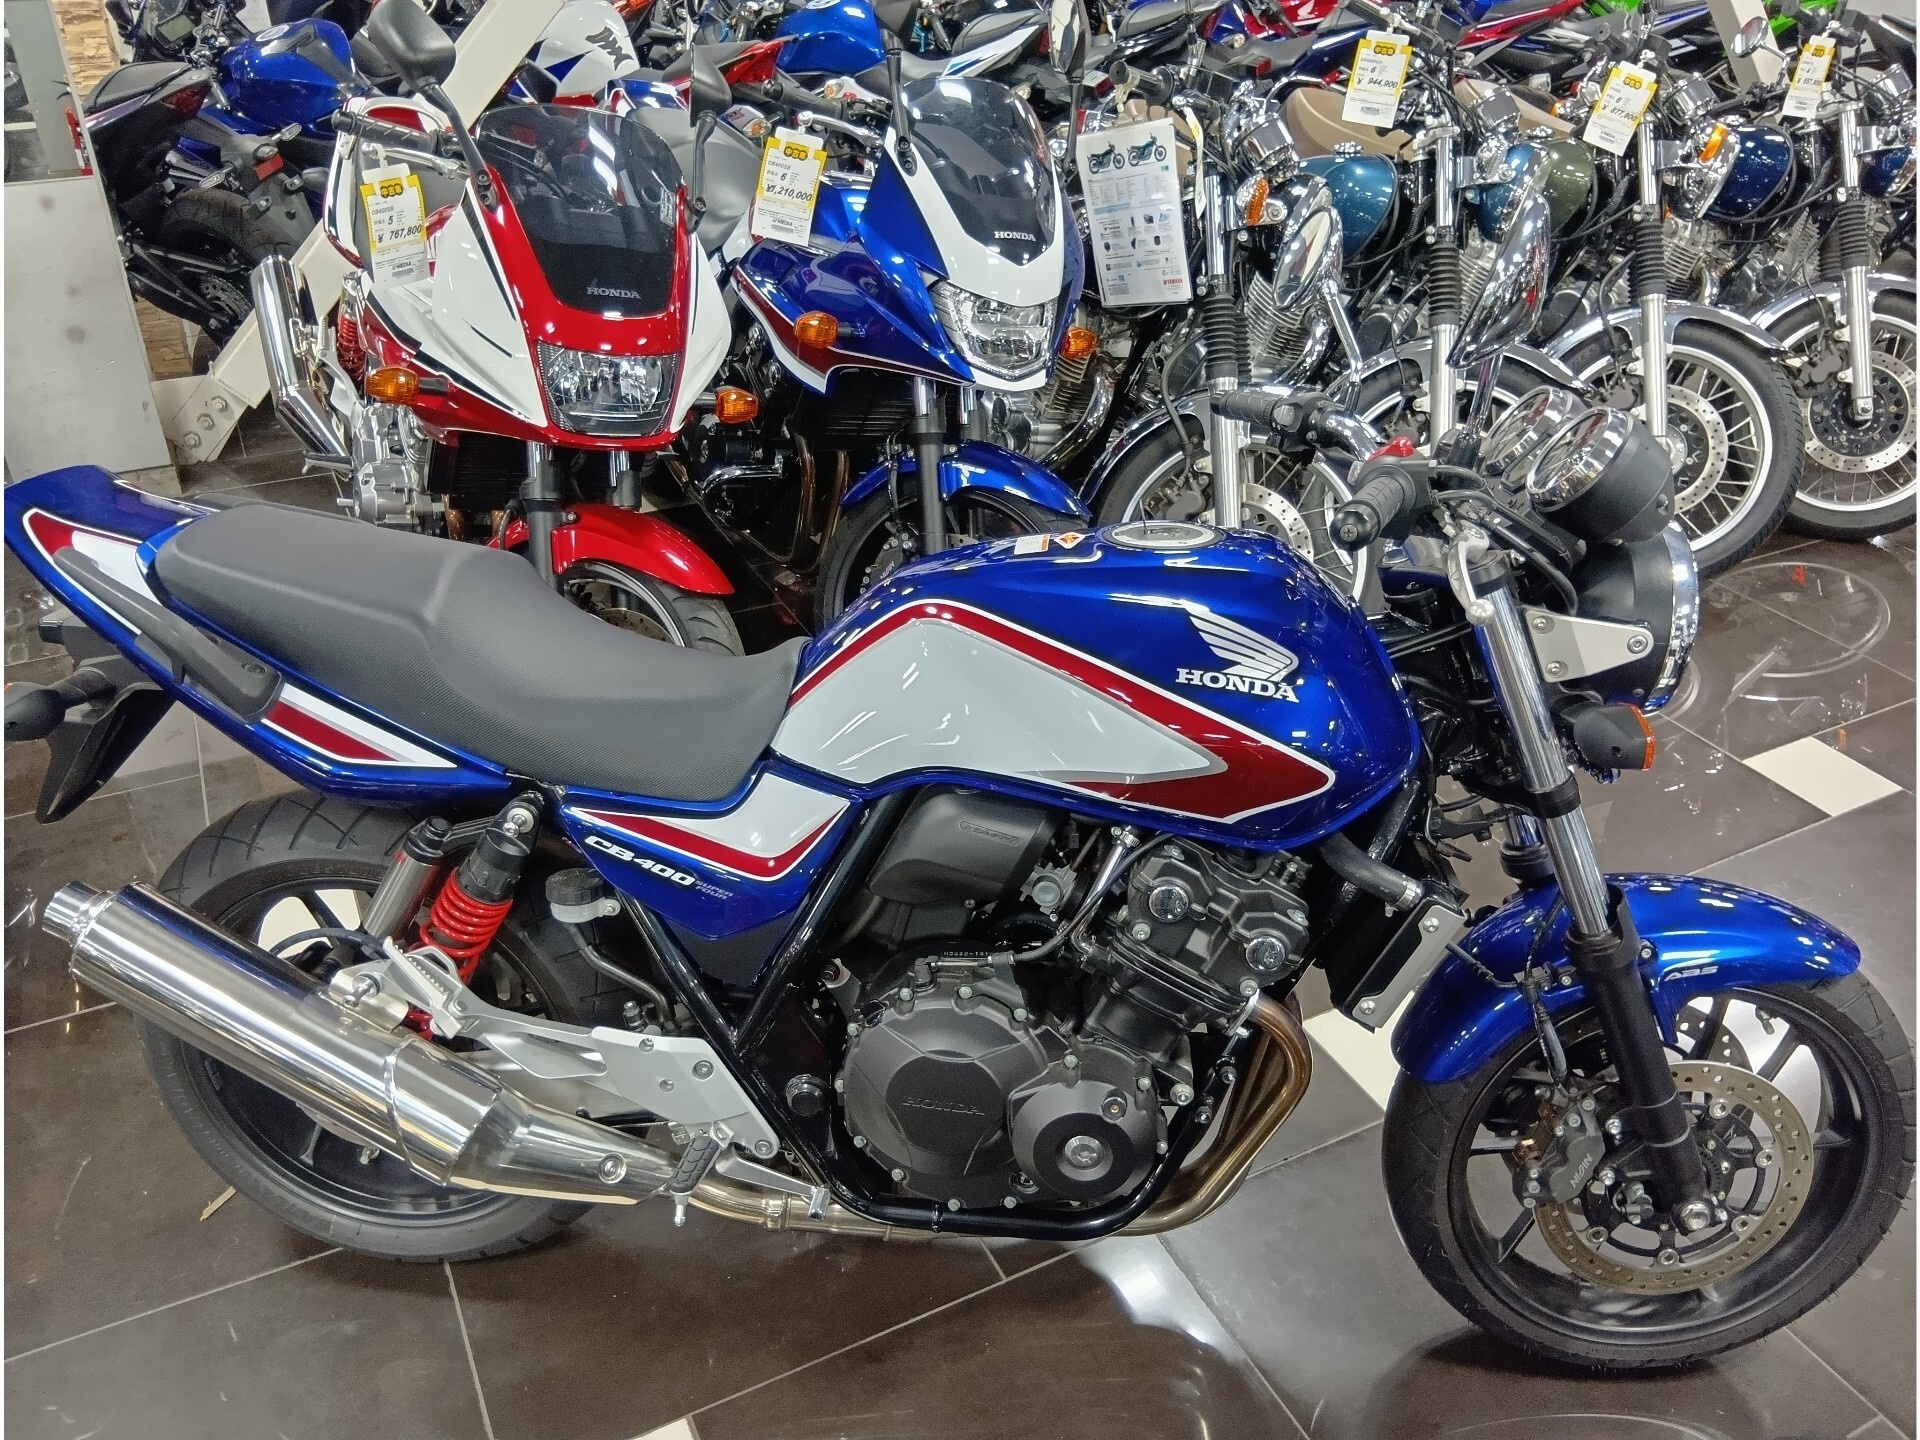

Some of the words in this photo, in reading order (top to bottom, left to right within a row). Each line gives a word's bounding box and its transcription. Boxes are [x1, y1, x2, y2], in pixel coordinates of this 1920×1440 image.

[1367, 77, 1398, 88] 944,900
[780, 172, 788, 181] 6
[387, 215, 394, 226] 5
[389, 224, 423, 241] 767,800
[993, 231, 1037, 242] HONDA
[586, 286, 642, 299] HONDA
[1175, 667, 1299, 703] HONDA
[584, 835, 696, 886] CB400
[695, 880, 733, 897] SUPER
[695, 885, 728, 900] FOUR
[1663, 965, 1719, 982] ABS
[902, 1096, 985, 1116] HONDA
[1570, 1153, 1593, 1189] NISSIN
